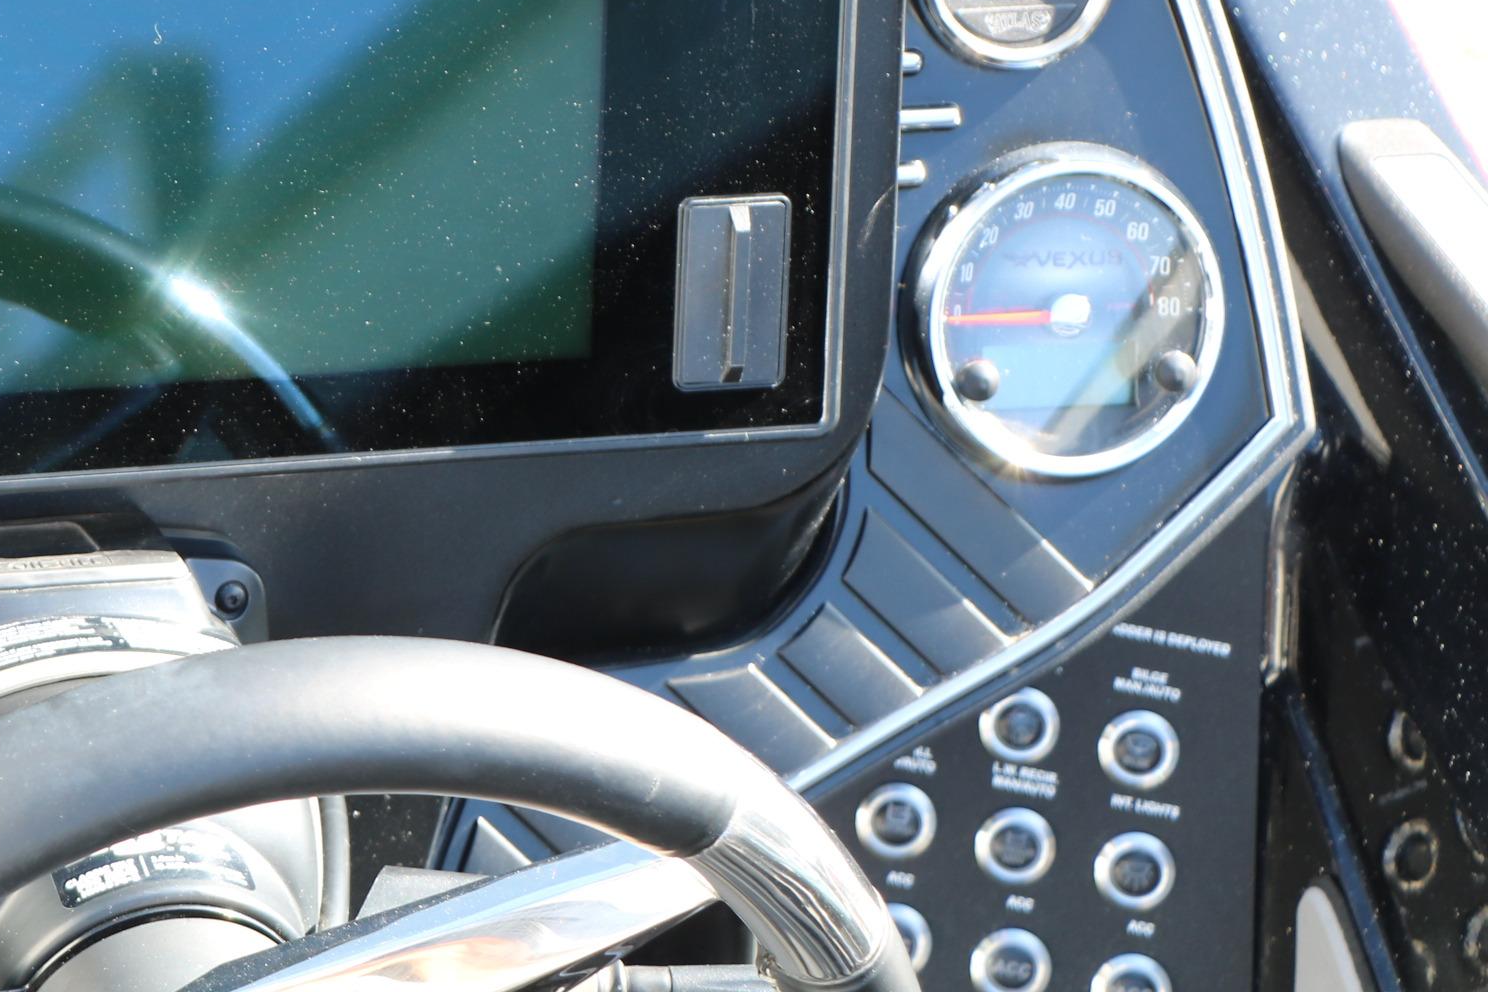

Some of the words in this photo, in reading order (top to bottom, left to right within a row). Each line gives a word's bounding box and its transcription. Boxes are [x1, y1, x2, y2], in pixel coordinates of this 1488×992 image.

[1014, 201, 1034, 219] 30
[1054, 192, 1076, 209] 40
[1094, 199, 1116, 217] 50
[980, 226, 999, 247] 20
[1127, 222, 1149, 241] 60
[1035, 249, 1122, 268] VEXUS
[1149, 255, 1171, 275] 70
[961, 262, 974, 283] 10
[1158, 296, 1181, 316] 80
[1167, 632, 1230, 656] DEPLOYED
[1134, 798, 1180, 819] LIGHTS
[887, 871, 914, 889] ACC
[1006, 895, 1034, 912] ACC
[1127, 919, 1155, 936] ACC
